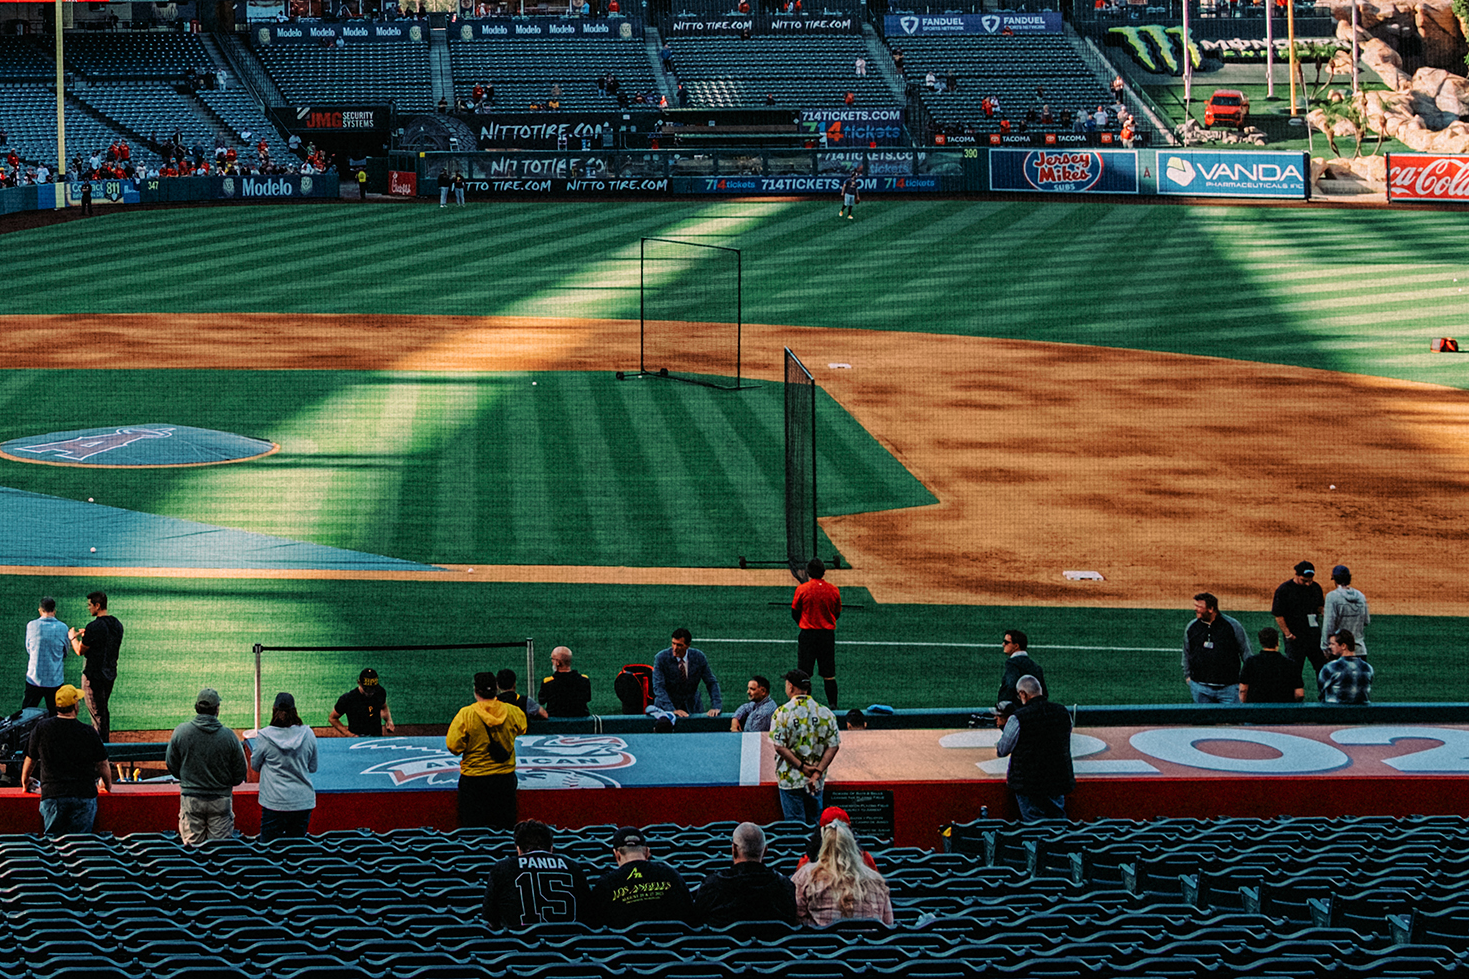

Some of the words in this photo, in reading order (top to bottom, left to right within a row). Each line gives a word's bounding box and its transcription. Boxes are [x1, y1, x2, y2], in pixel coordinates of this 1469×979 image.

[673, 21, 704, 31] NITTO
[706, 20, 752, 31] TIRE.COM
[771, 20, 802, 30] NITTO
[804, 19, 851, 29] TIRE.COM
[922, 17, 964, 25] FANDUEL
[1003, 16, 1045, 24] FANDUEL
[276, 28, 302, 37] Modelo
[310, 27, 335, 37] Modelo
[343, 27, 368, 36] Modelo
[376, 26, 401, 36] Modelo
[481, 25, 508, 35] Modelo
[515, 24, 541, 35] Modelo
[549, 24, 575, 34] Modelo
[582, 23, 609, 33] Modelo
[306, 112, 342, 128] JMG
[342, 111, 374, 120] SECURITY
[801, 110, 901, 121] 714TICKETS.COM
[342, 120, 374, 128] SYSTEMS
[1001, 135, 1031, 143] TACOMA
[964, 148, 978, 159] 390
[1034, 152, 1091, 168] Jersey
[1038, 167, 1092, 183] Mike's
[1196, 163, 1304, 182] VANDA
[242, 178, 292, 197] Modelo
[491, 180, 551, 192] TIRE.COM
[566, 179, 605, 191] NITTO
[607, 179, 668, 191] TIRE.COM
[761, 178, 878, 191] 714TICKETS.OM
[517, 856, 568, 870] PANDA
[514, 872, 576, 923] 15
